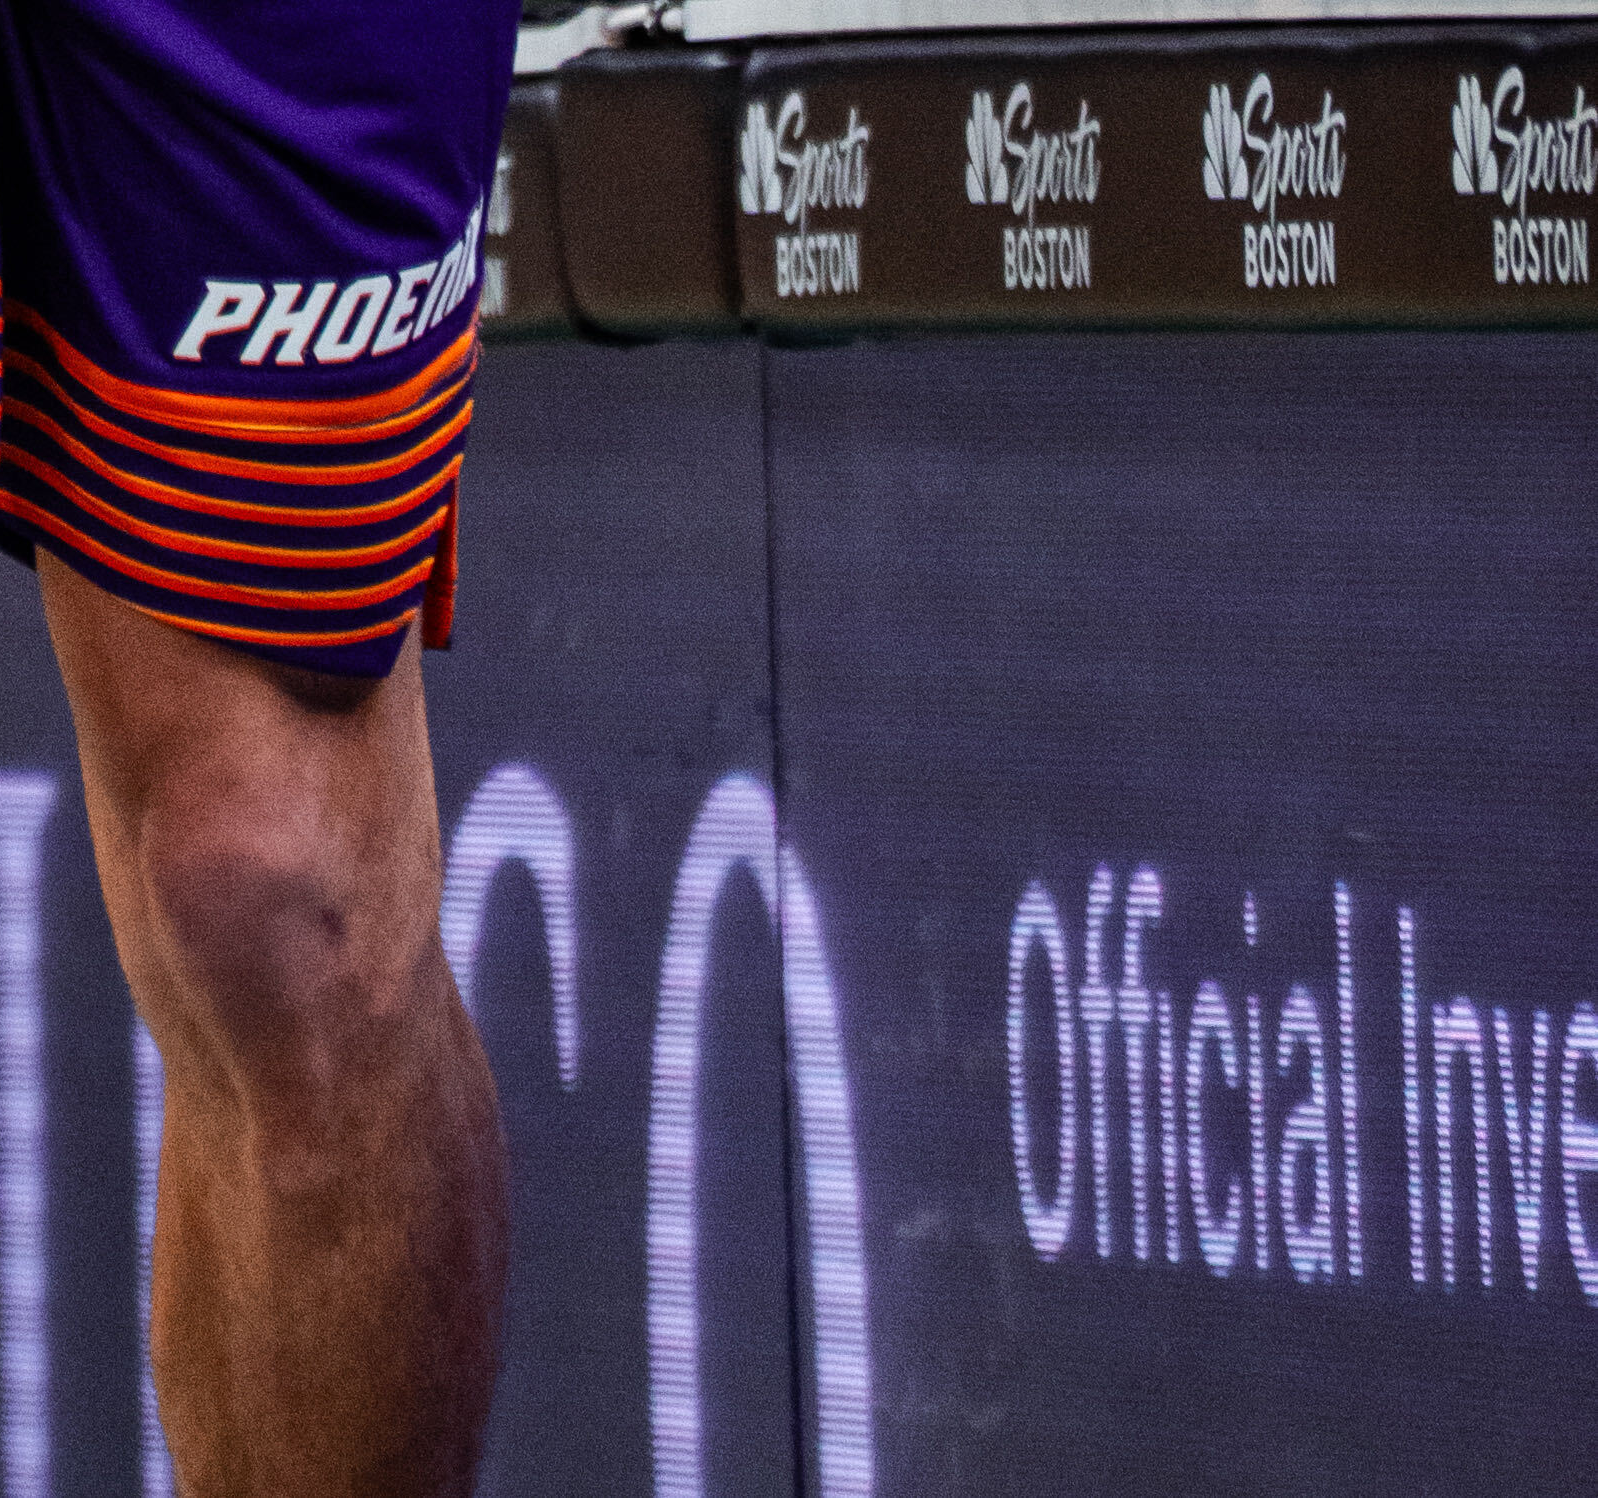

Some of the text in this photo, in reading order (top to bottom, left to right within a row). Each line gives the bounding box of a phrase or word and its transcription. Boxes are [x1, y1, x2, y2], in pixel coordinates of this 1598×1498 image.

[776, 90, 870, 231] Sports
[1004, 81, 1102, 228] Sports
[1243, 71, 1347, 224] Sports
[1492, 64, 1598, 222] Sports
[775, 232, 860, 297] BOSTON
[1003, 226, 1091, 290] BOSTON
[1244, 220, 1336, 288] BOSTON
[1492, 216, 1589, 285] BOSTON
[1006, 861, 1365, 1284] Official
[1398, 904, 1598, 1306] Inve
